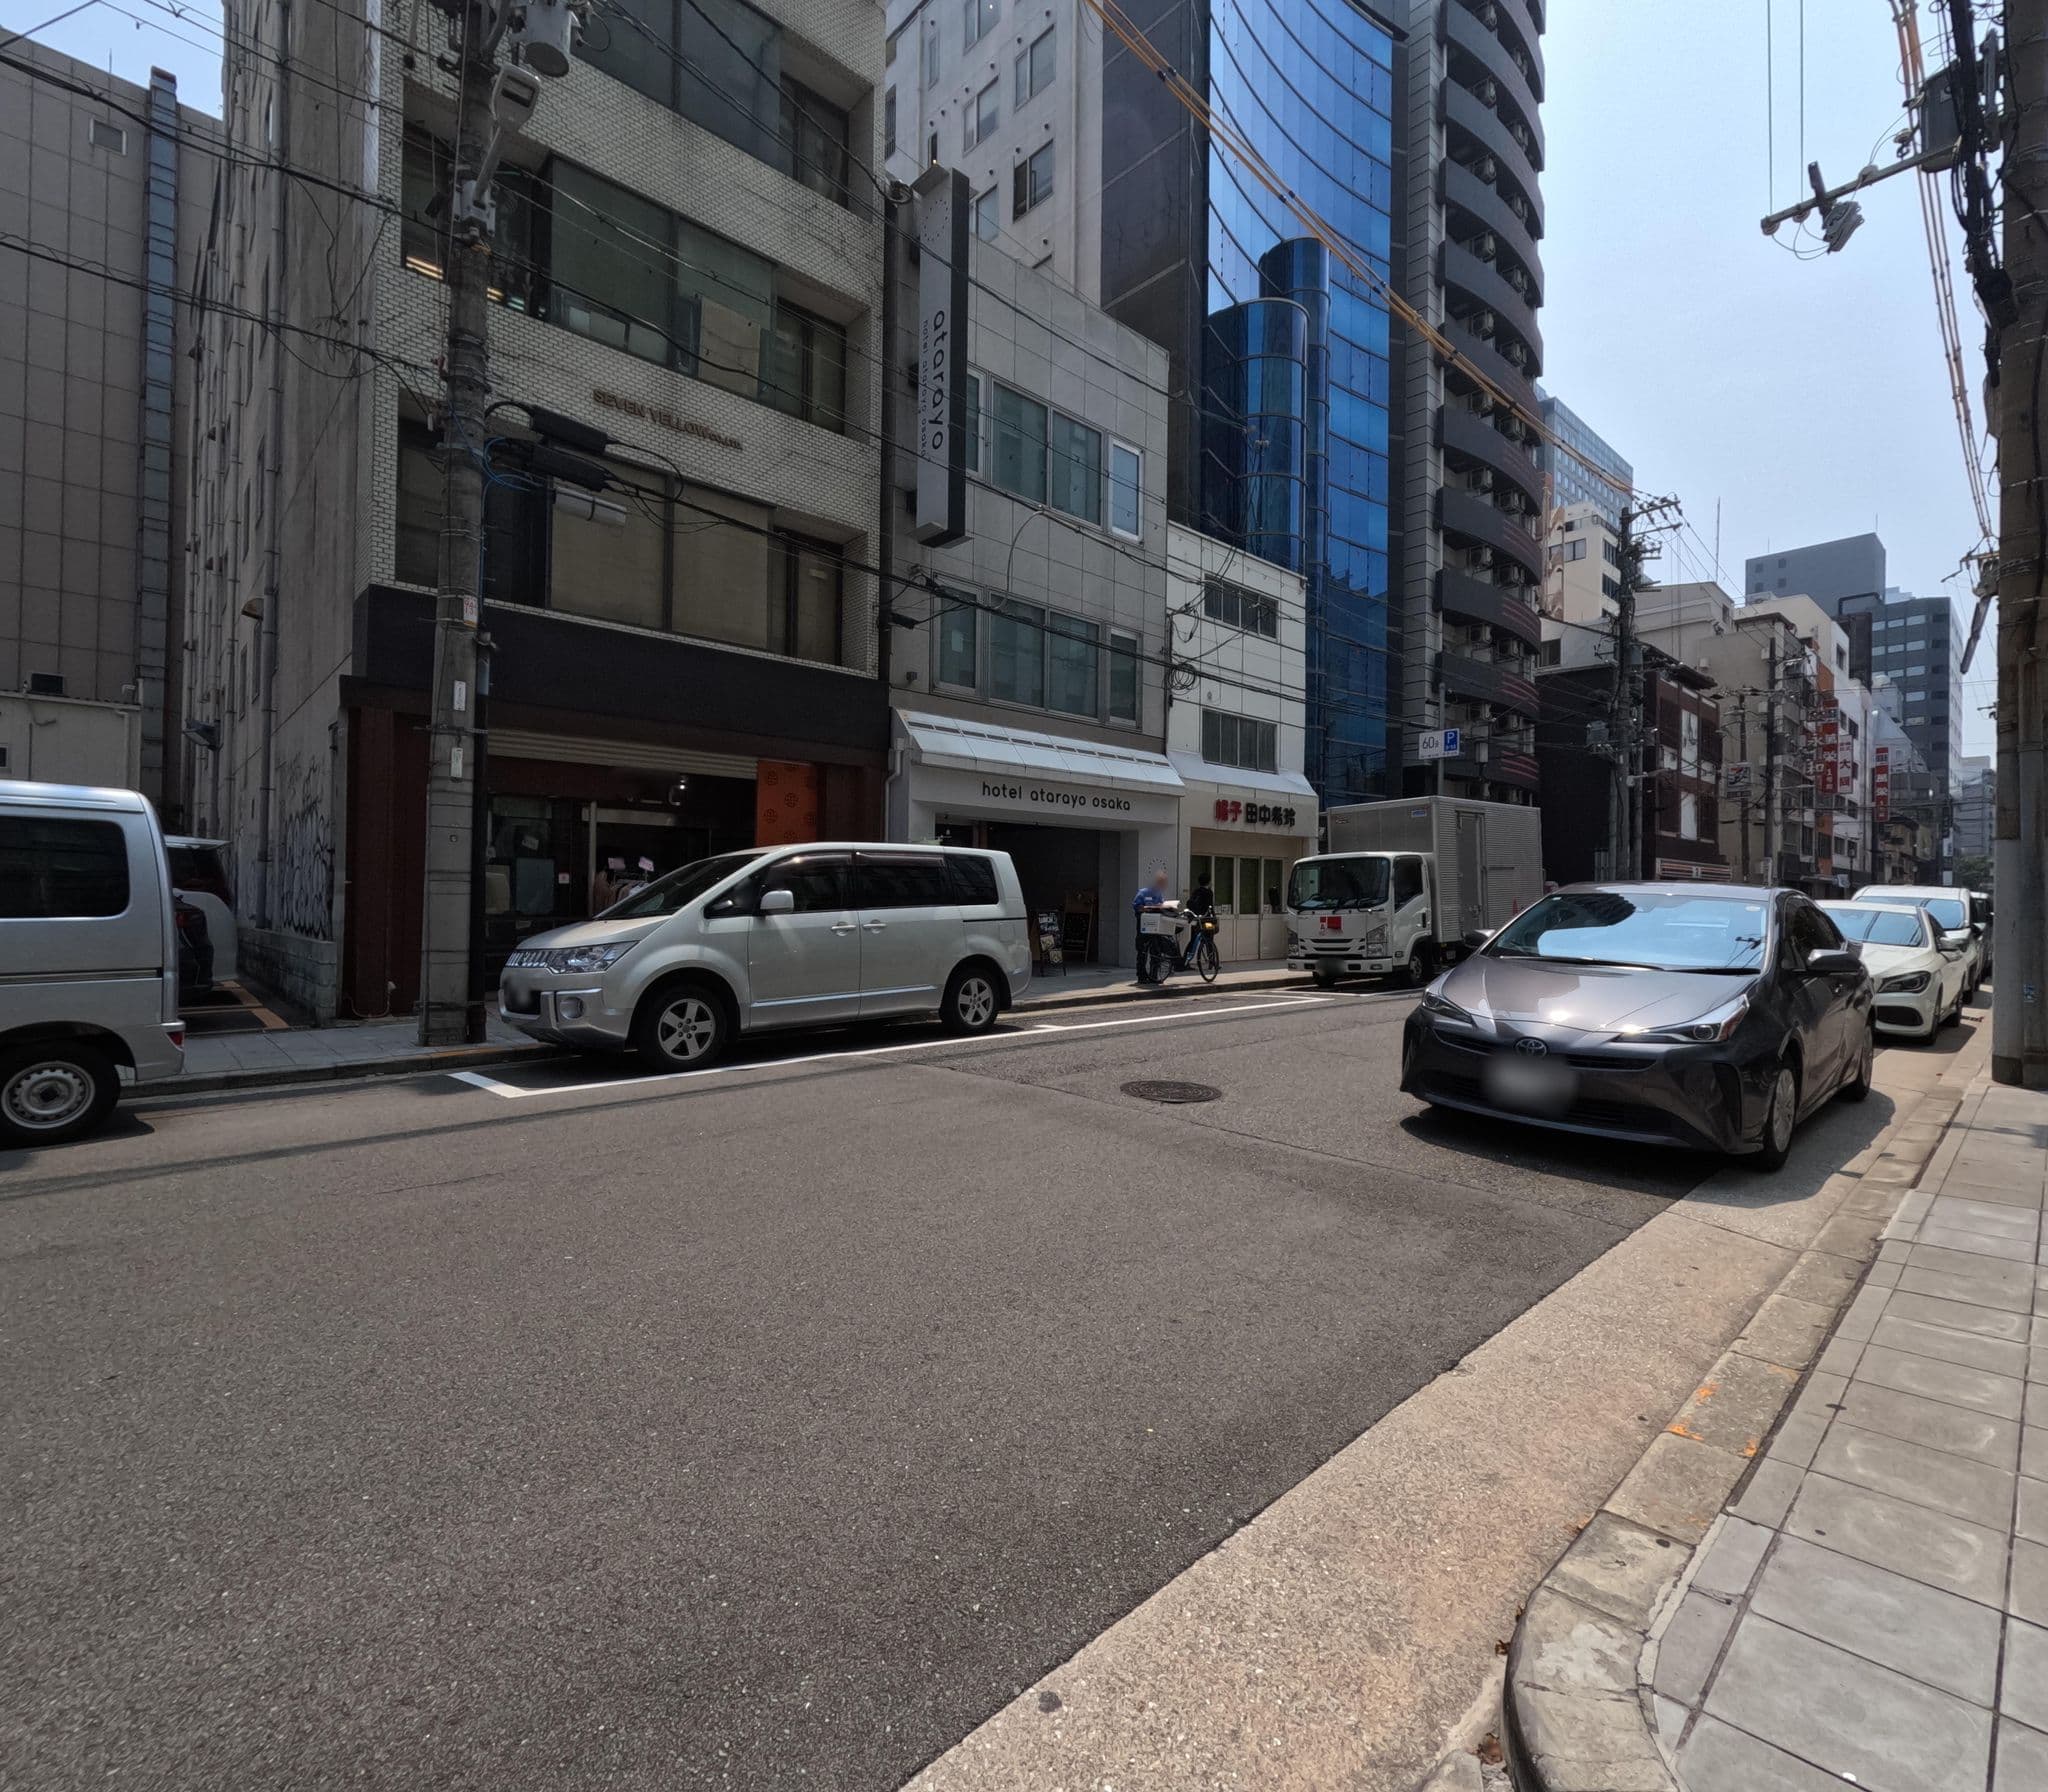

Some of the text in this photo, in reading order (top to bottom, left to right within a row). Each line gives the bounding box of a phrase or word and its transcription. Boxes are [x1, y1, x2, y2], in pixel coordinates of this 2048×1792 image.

[920, 319, 929, 458] hotel atarayo osaka
[928, 310, 948, 450] atarayo
[593, 389, 646, 418] SEVEN
[648, 407, 710, 440] YELLOW
[1447, 732, 1455, 744] P
[982, 781, 1131, 811] hotel atarayo osaka
